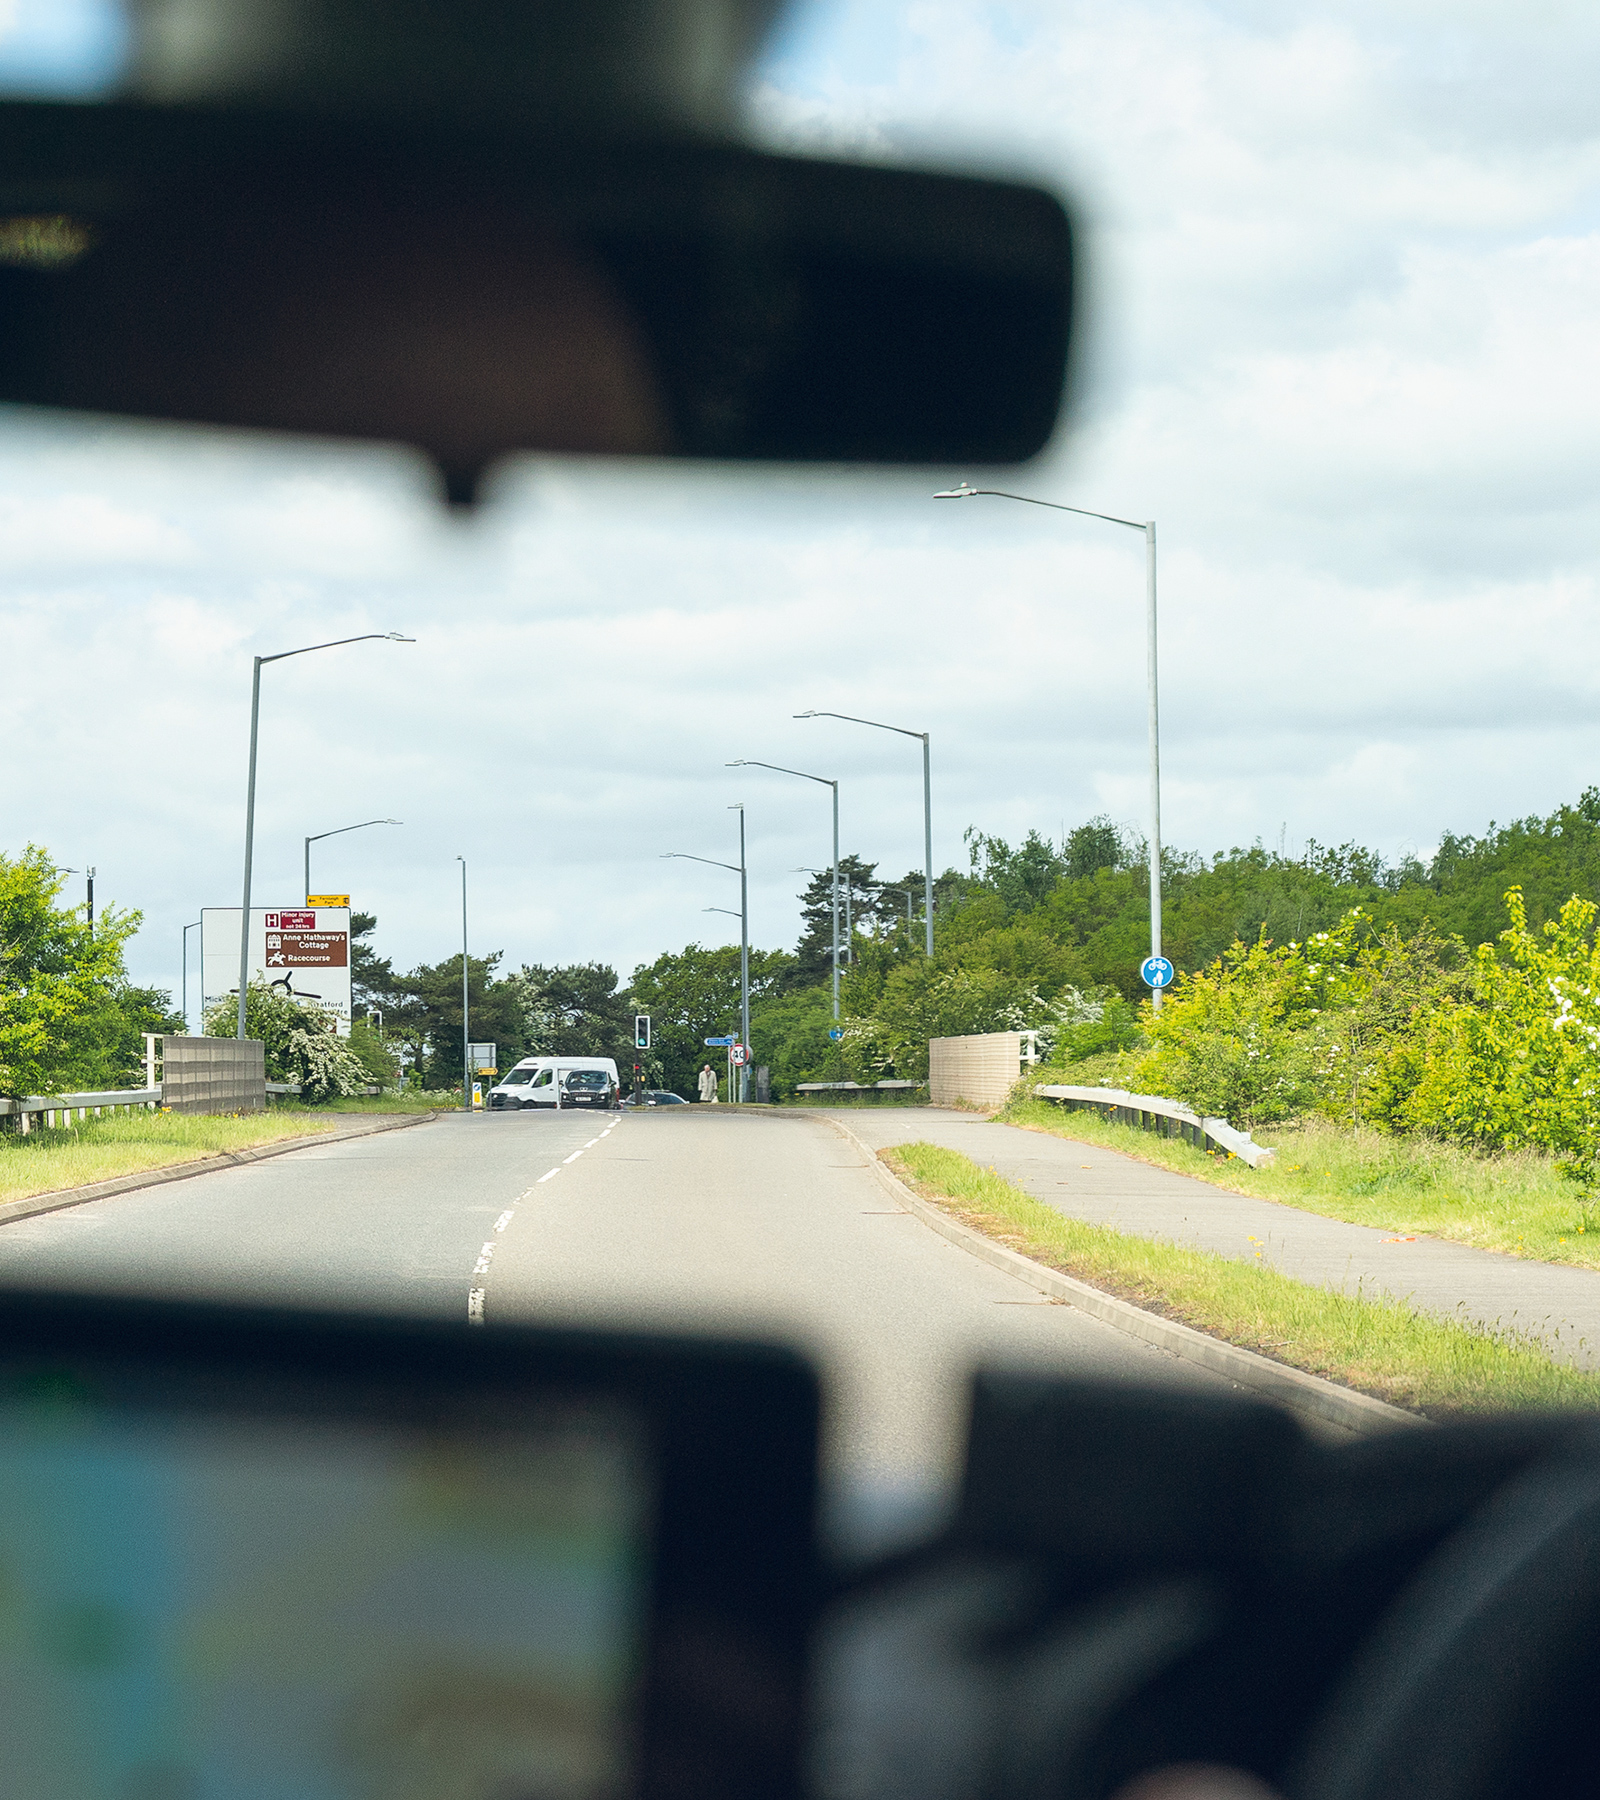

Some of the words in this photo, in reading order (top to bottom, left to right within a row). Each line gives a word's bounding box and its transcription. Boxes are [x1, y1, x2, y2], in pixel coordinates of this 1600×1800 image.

[267, 915, 277, 926] H
[304, 934, 345, 942] Hathaway's
[299, 942, 330, 950] Cottage
